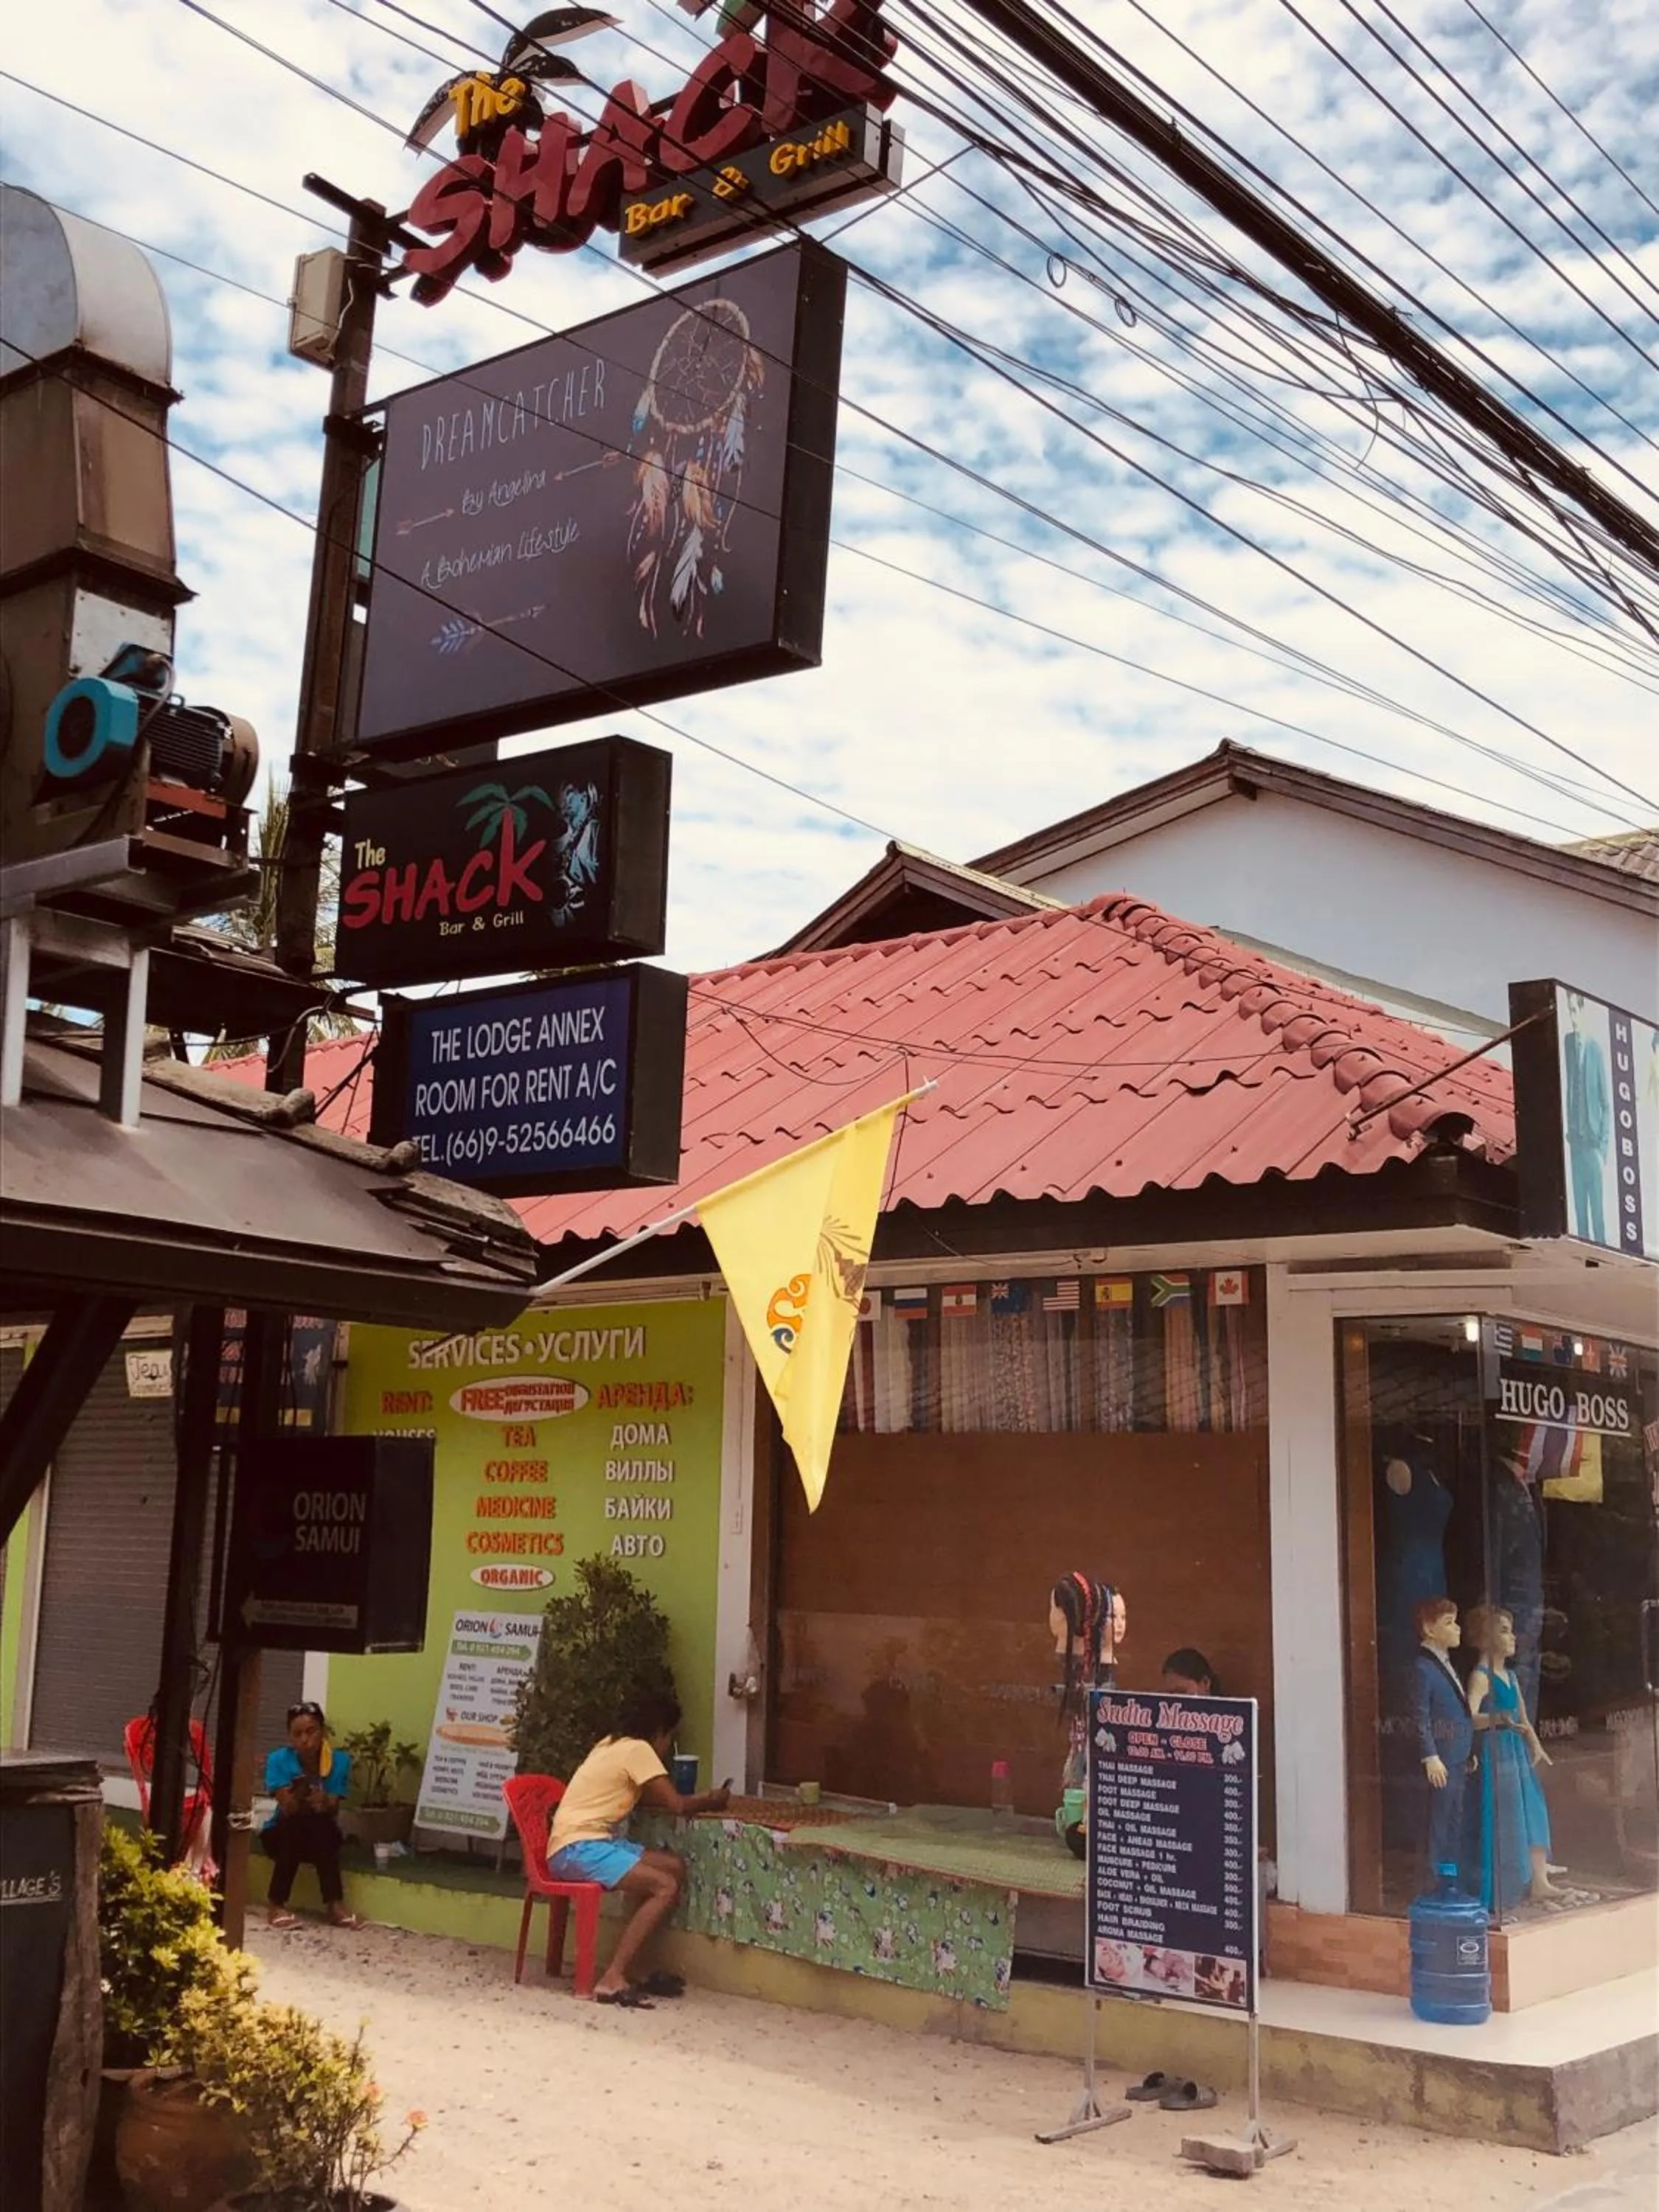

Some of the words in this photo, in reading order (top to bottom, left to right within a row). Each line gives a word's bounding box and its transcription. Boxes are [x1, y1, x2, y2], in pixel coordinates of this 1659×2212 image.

[449, 72, 526, 138] The
[403, 0, 898, 274] SHACK
[624, 190, 695, 237] Bar
[712, 167, 748, 198] &
[769, 120, 850, 178] Grill
[421, 358, 605, 470] DREAMCATCHER
[462, 487, 484, 515] By
[437, 543, 512, 585] Bohemian
[517, 518, 582, 560] Lifestyle
[355, 839, 386, 870] The
[342, 808, 547, 930] SHACK
[439, 921, 462, 936] Bar
[473, 917, 485, 931] &
[493, 910, 524, 928] Grill
[432, 1028, 461, 1063] THE
[467, 1016, 532, 1060] LODGE
[537, 1006, 605, 1050] ANNEX
[414, 1077, 476, 1117] ROOM
[481, 1072, 518, 1110] FOR
[525, 1064, 572, 1104] RENT
[576, 1058, 617, 1100] A/C
[538, 1326, 645, 1364] УСЛУГИ
[461, 1388, 504, 1411] FREE
[1500, 1378, 1565, 1420] HUGO
[1576, 1391, 1629, 1430] BOSS
[502, 1425, 536, 1447] TEA
[611, 1423, 670, 1450] ДОМА
[484, 1460, 549, 1483] COFFEE
[605, 1459, 674, 1482] ВИЛЛЫ
[293, 1492, 366, 1523] ORION
[476, 1495, 557, 1519] MEDICINE
[605, 1493, 672, 1520] БАЙКИ
[295, 1525, 361, 1554] SAMUI
[466, 1531, 565, 1555] COSMETICS
[611, 1534, 665, 1557] АВТО
[481, 1568, 544, 1586] ORGANIC
[455, 1618, 488, 1634] ORION
[1156, 1702, 1244, 1744] Massage
[1127, 1731, 1158, 1745] OPEN
[1169, 1734, 1207, 1750] CLOSE
[1097, 1901, 1120, 1912] FOOT
